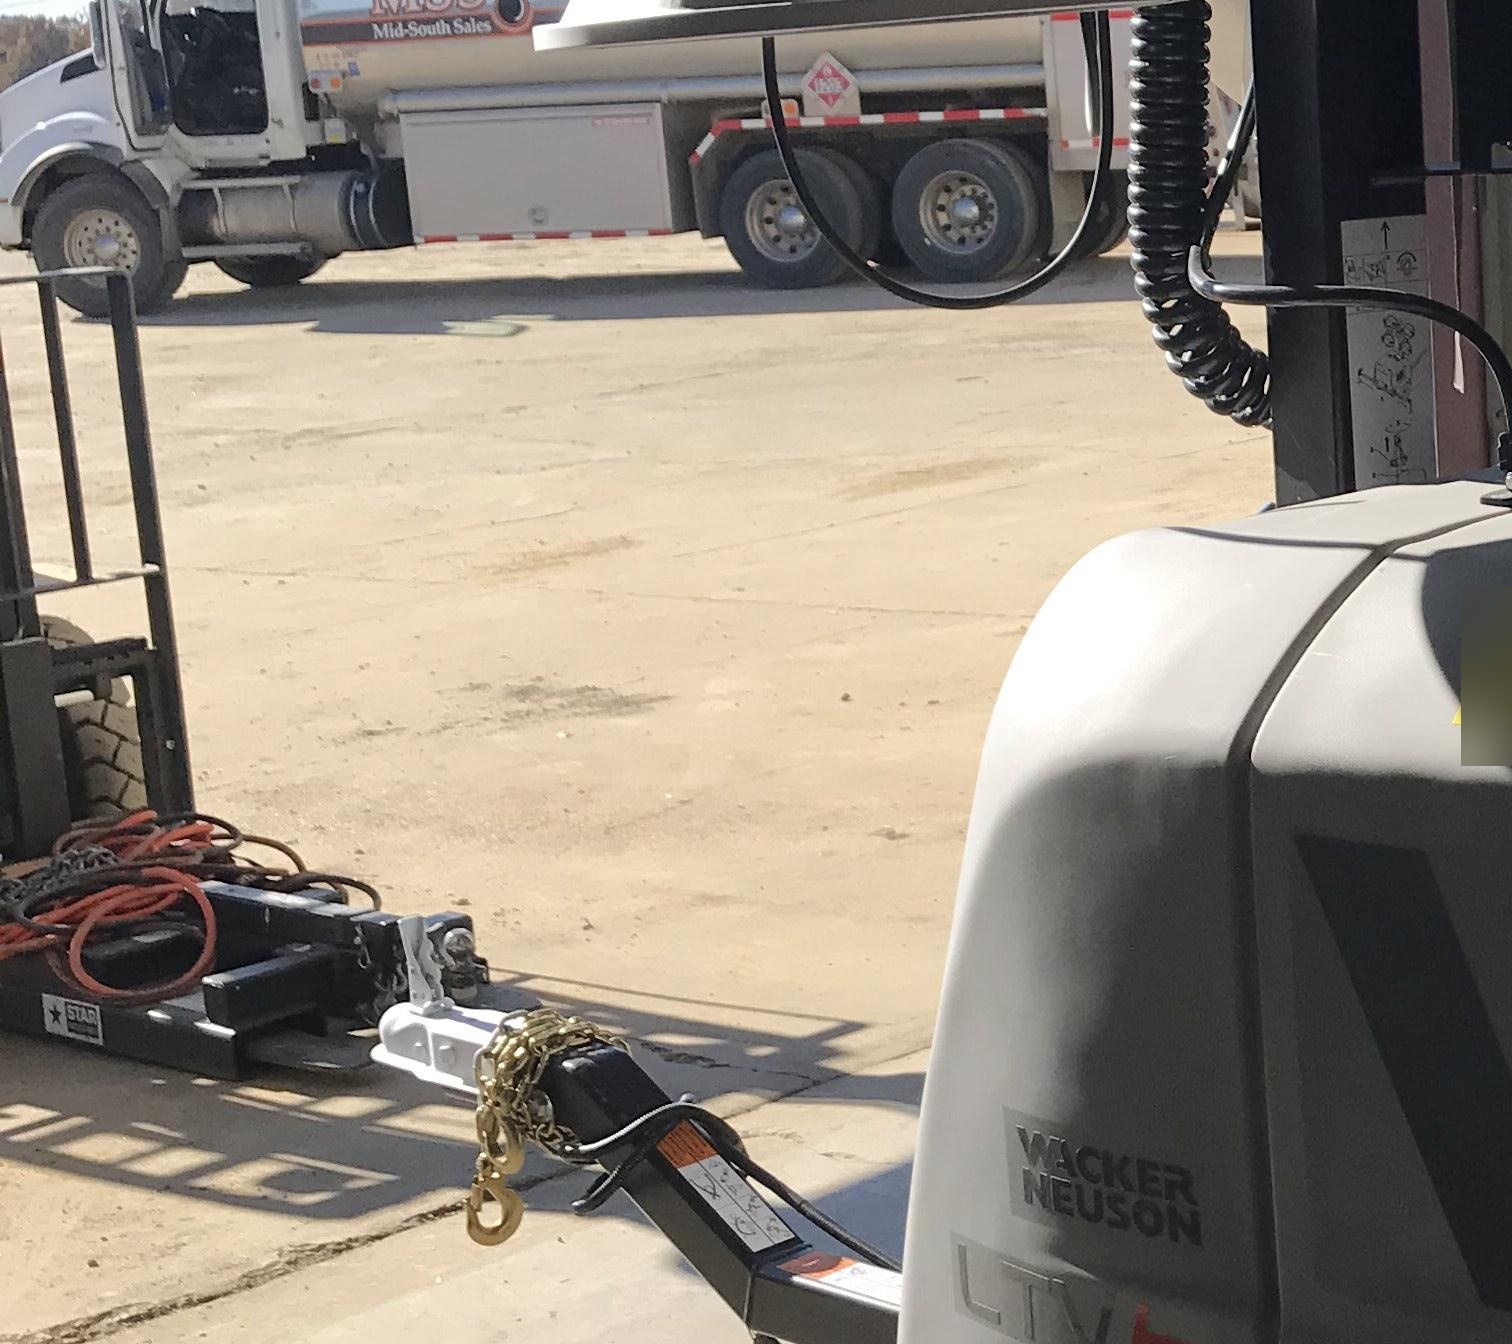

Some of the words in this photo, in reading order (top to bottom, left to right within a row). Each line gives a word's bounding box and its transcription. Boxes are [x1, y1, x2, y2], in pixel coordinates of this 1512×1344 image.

[373, 19, 450, 40] Mid-South
[453, 17, 492, 35] Sales
[67, 1004, 97, 1025] STAR
[1015, 1123, 1200, 1207] WACKER
[1021, 1166, 1203, 1246] NEUSON
